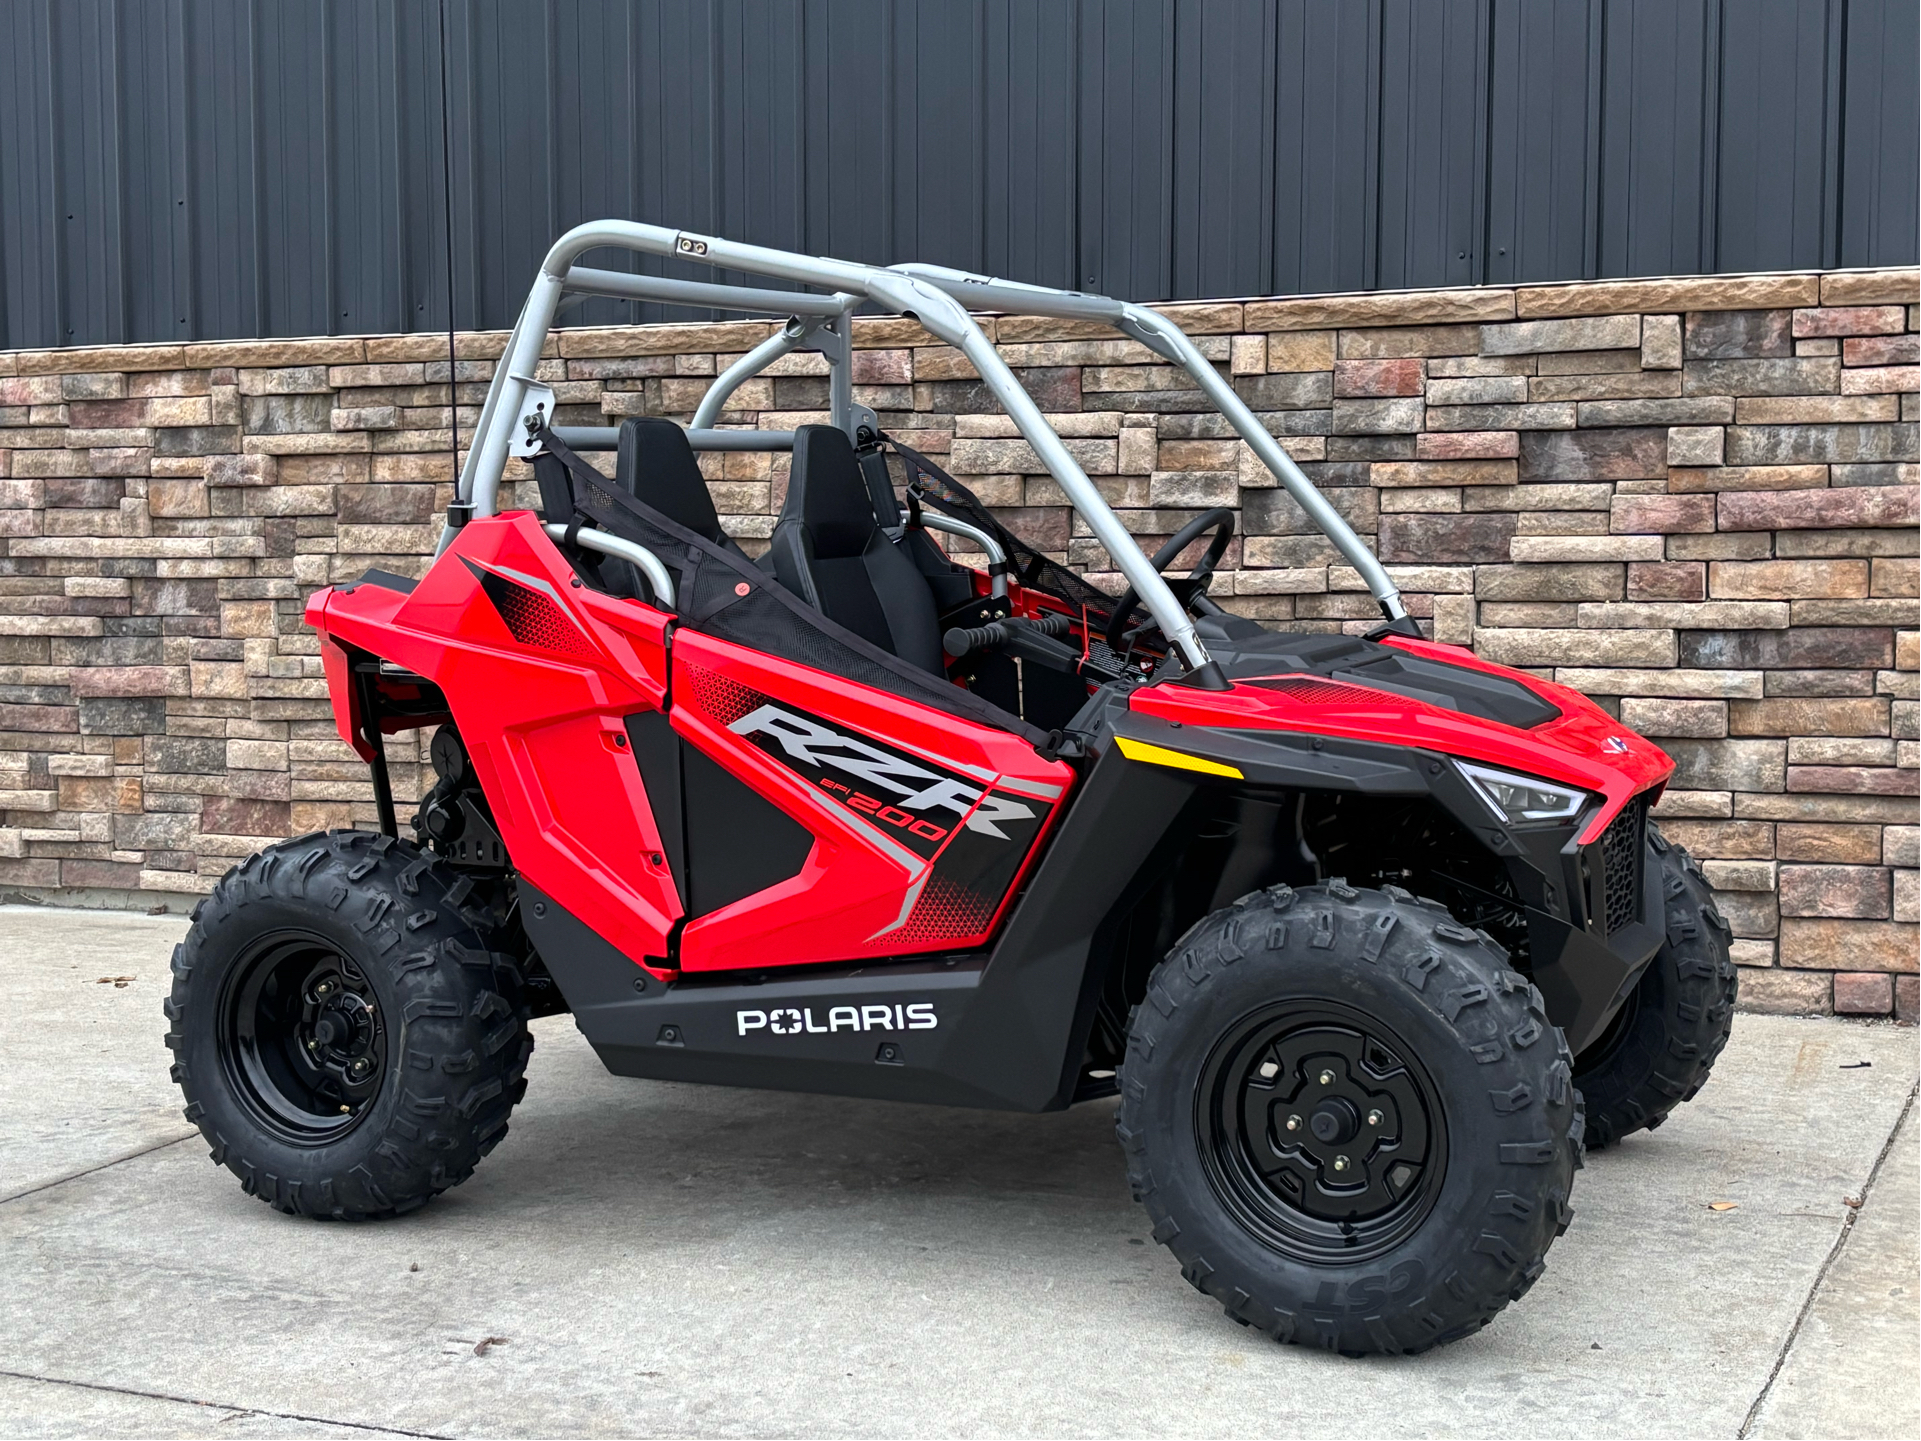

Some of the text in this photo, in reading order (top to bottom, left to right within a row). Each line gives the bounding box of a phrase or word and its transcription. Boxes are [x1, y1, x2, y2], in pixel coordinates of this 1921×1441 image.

[727, 704, 1037, 841] RZR
[820, 777, 949, 842] EFI 200
[736, 1003, 939, 1036] POLARIS
[1301, 1258, 1427, 1314] CST
